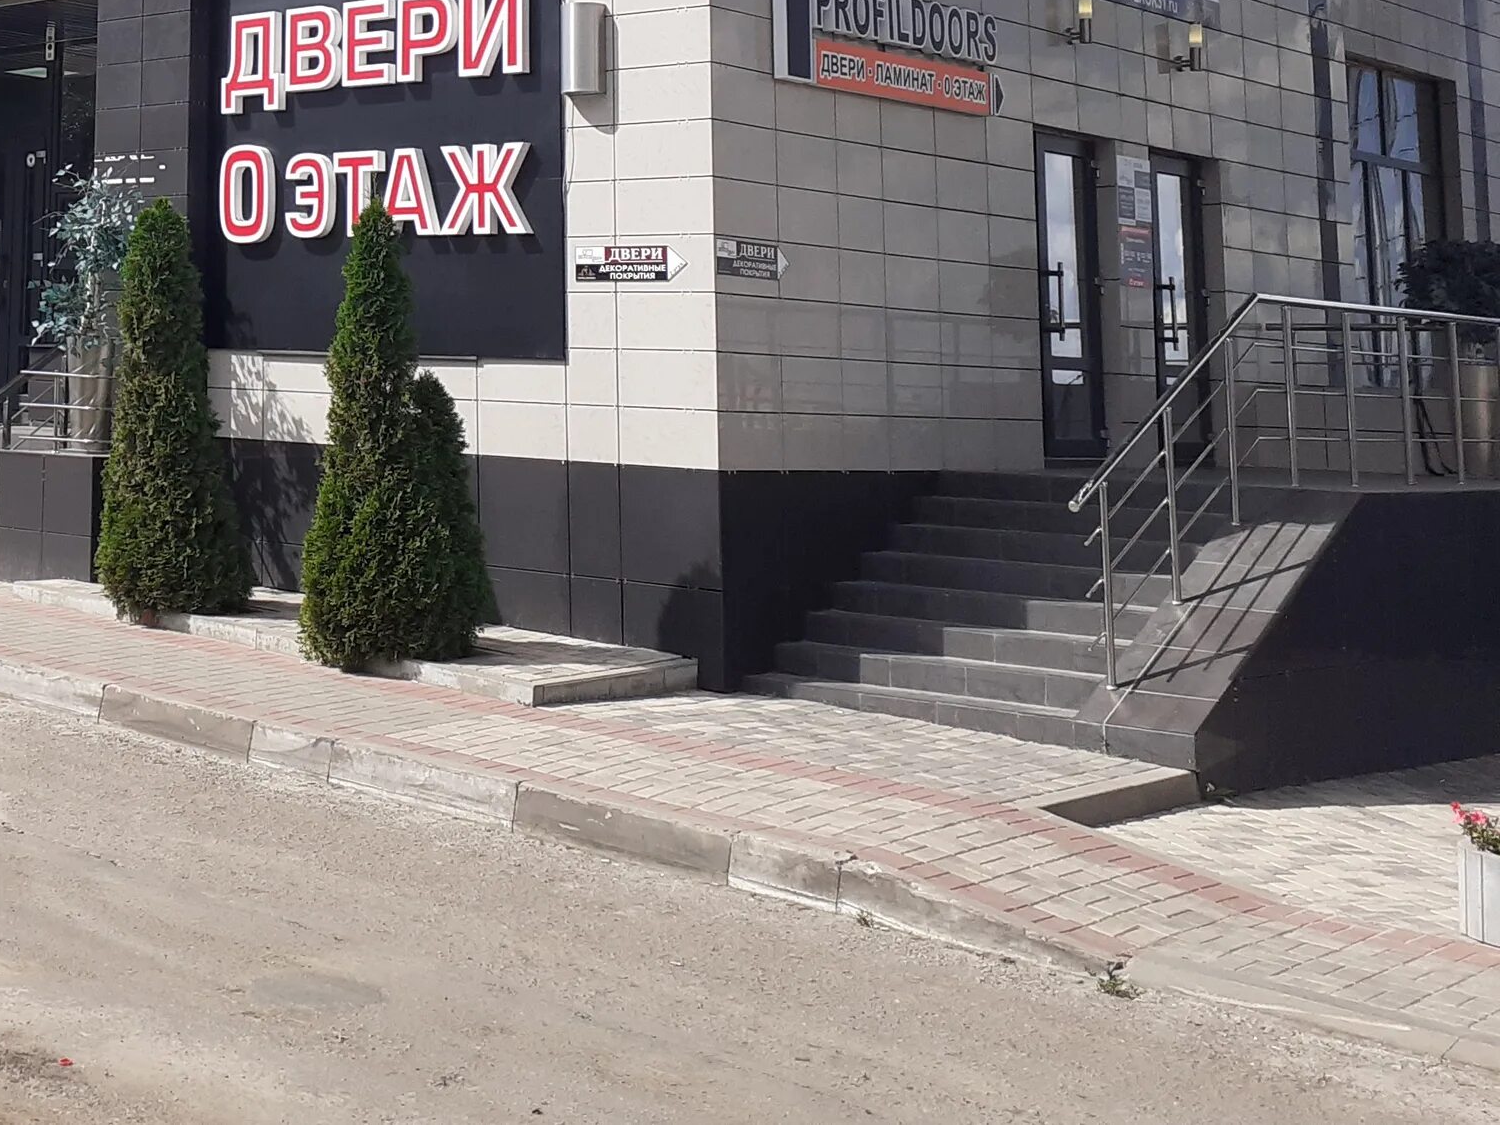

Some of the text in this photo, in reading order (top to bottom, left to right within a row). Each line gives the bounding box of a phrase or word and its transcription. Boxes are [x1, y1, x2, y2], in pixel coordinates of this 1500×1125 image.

[820, 51, 866, 81] ДВЕРИ
[874, 62, 936, 93] ЛАМИНАТ
[952, 79, 987, 105] ЭТАЖ
[285, 142, 534, 239] ЭТАЖ
[609, 247, 664, 262] ДВЕРИ
[739, 243, 776, 260] ДВЕРИ
[599, 264, 667, 273] ДЕКОРАТИВНЫЕ
[733, 260, 777, 272] ДЕКОРАТИВНЫЕ
[609, 272, 656, 280] ПОКРЫТИЯ
[740, 268, 771, 278] ПОКРЫТИЯ
